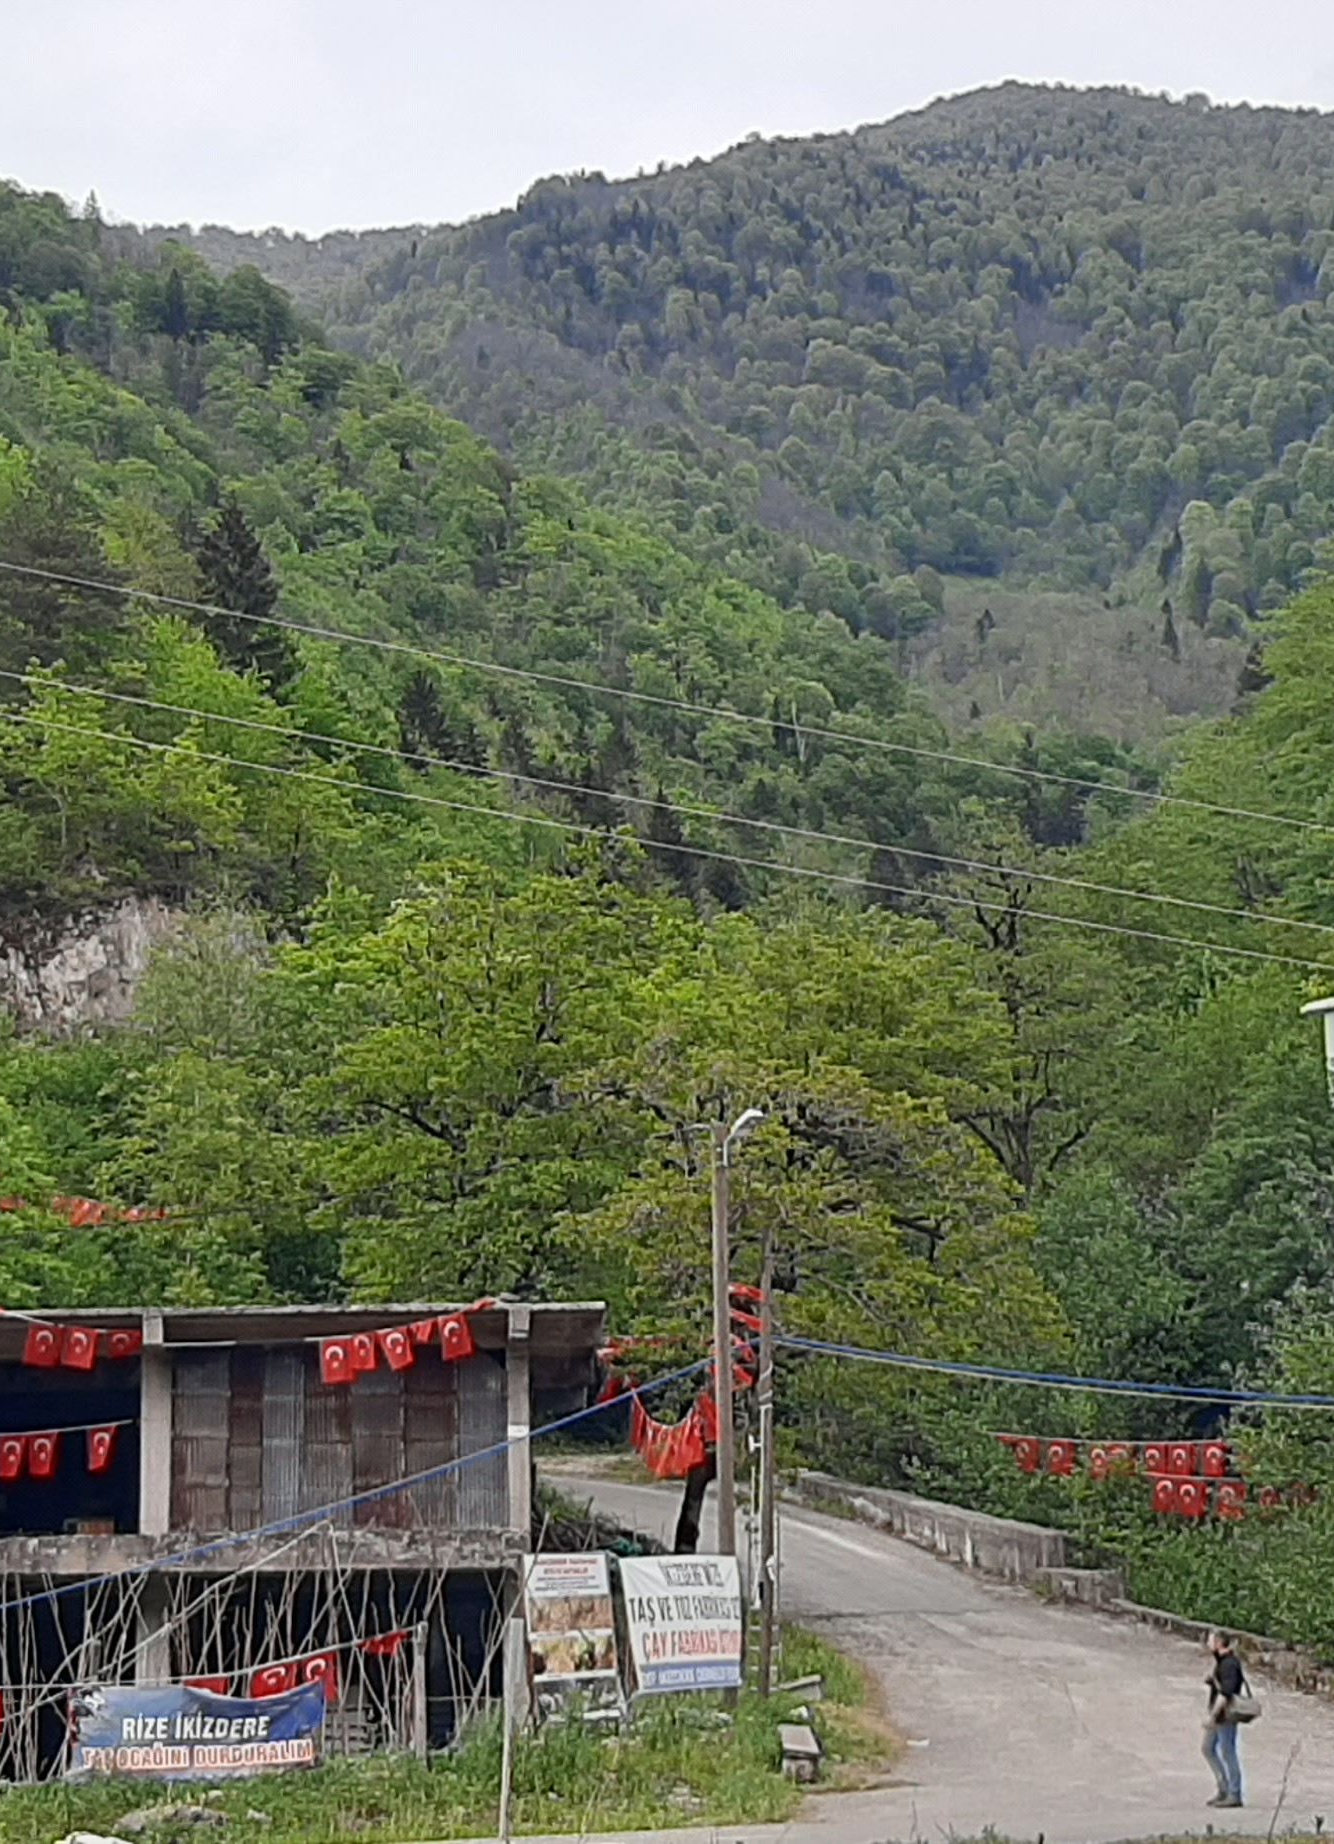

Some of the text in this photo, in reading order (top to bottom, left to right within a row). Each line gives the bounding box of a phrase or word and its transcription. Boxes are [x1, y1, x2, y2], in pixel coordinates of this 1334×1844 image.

[629, 1596, 656, 1628] TAŞ
[641, 1630, 667, 1662] ÇAY
[122, 1711, 270, 1741] RİZE İKİZDERE
[194, 1738, 313, 1767] DURDURALIM
